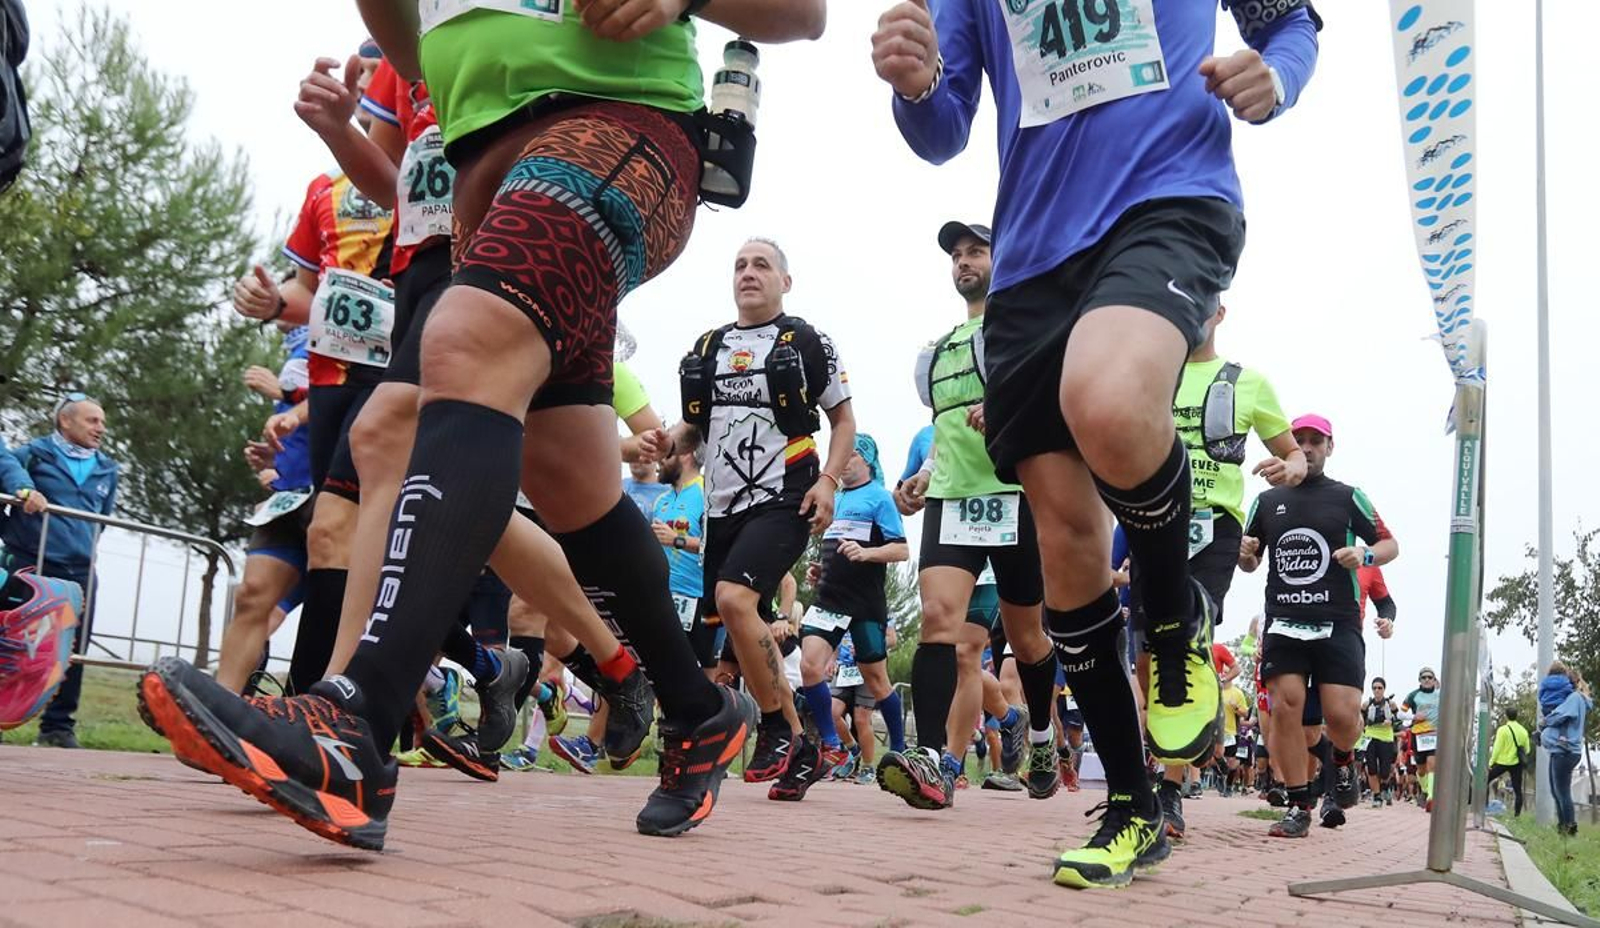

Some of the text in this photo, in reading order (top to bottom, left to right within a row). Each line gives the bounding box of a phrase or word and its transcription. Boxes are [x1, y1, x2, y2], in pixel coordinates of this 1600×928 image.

[1039, 0, 1121, 60] 419
[1050, 49, 1126, 86] Panterovic
[408, 156, 450, 203] 26
[323, 292, 374, 331] 163
[500, 279, 552, 328] WONG
[1460, 440, 1473, 515] ALQUIVALLE
[960, 497, 1004, 523] 198
[1276, 545, 1319, 558] Donando
[1276, 556, 1319, 573] Vidas
[1276, 590, 1330, 604] mobel
